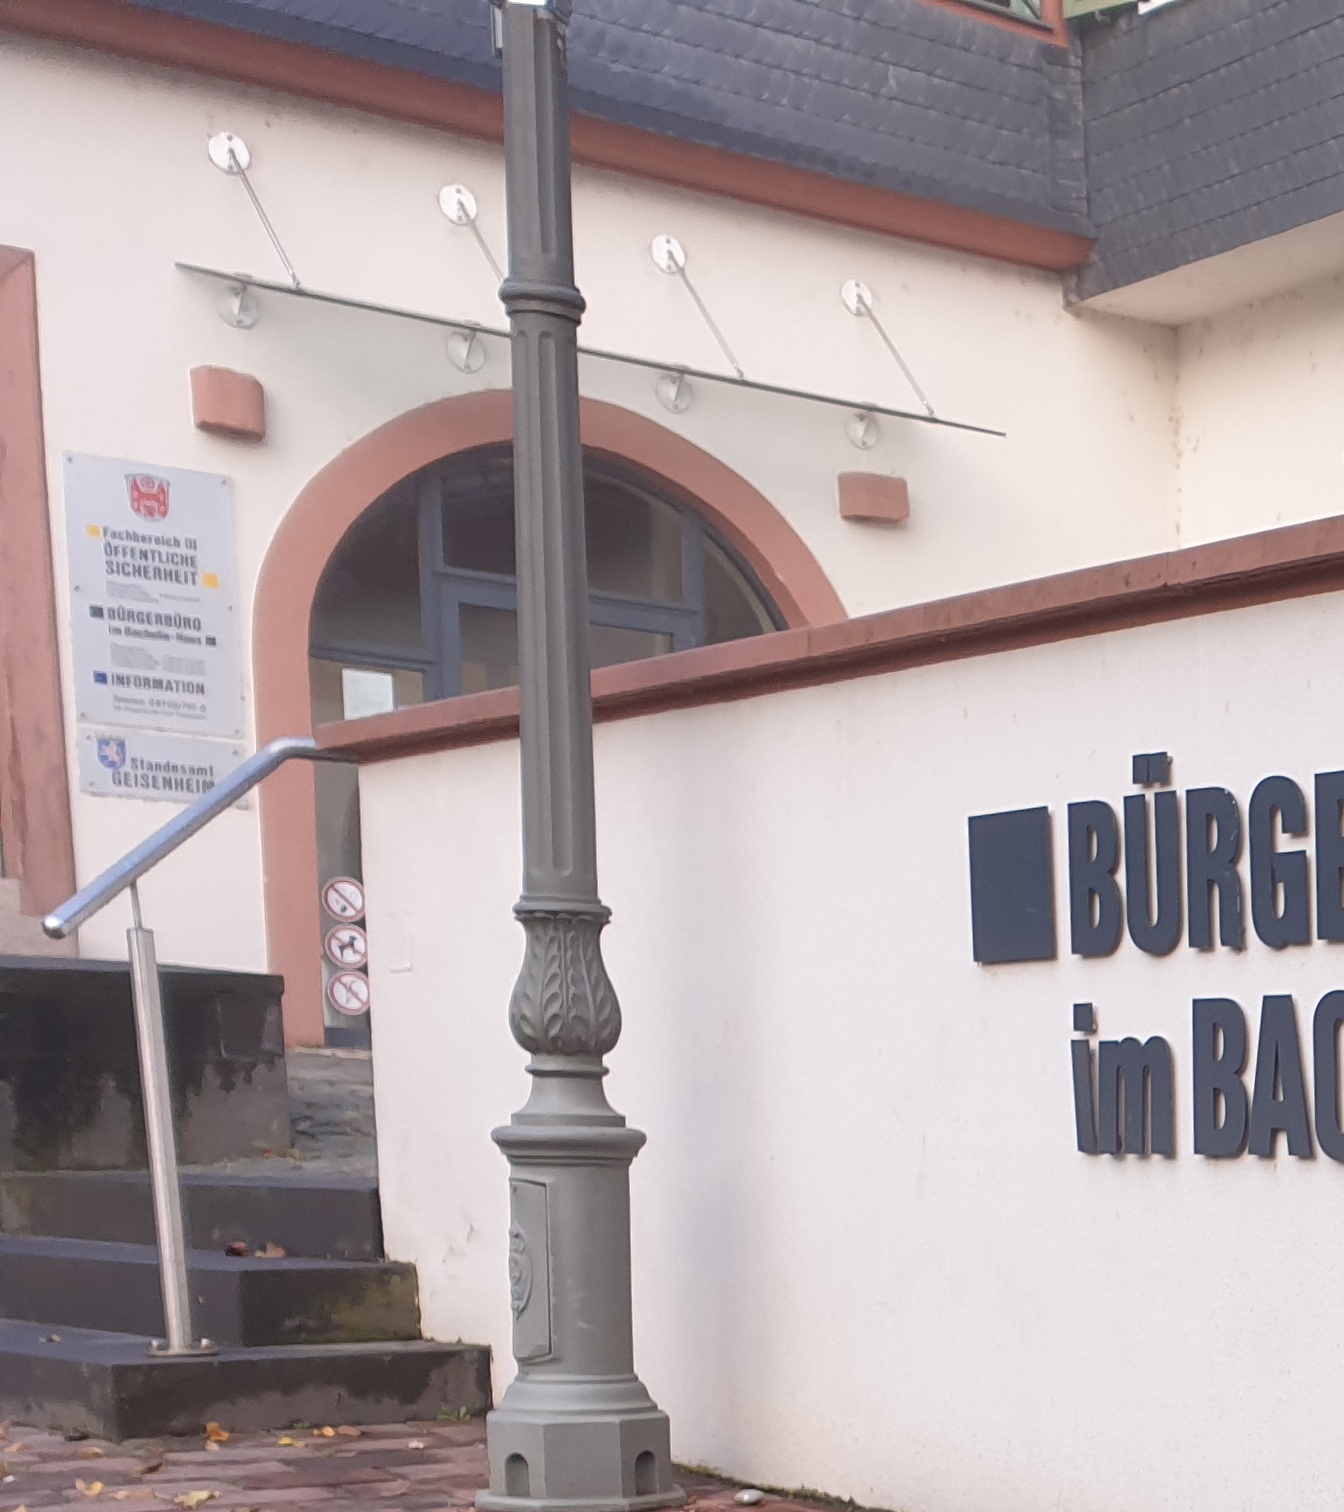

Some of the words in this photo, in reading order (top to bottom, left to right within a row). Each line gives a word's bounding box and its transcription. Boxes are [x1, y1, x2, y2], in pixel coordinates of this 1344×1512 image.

[103, 540, 198, 568] ÖFFENTLICHE
[105, 560, 197, 586] SICHERHEIT
[107, 604, 201, 632] BÜRGERBÜRO
[111, 672, 205, 695] INFORMATION
[131, 757, 214, 777] Standesamt
[112, 769, 215, 794] GEISENHEIM
[1071, 1003, 1177, 1158] im
